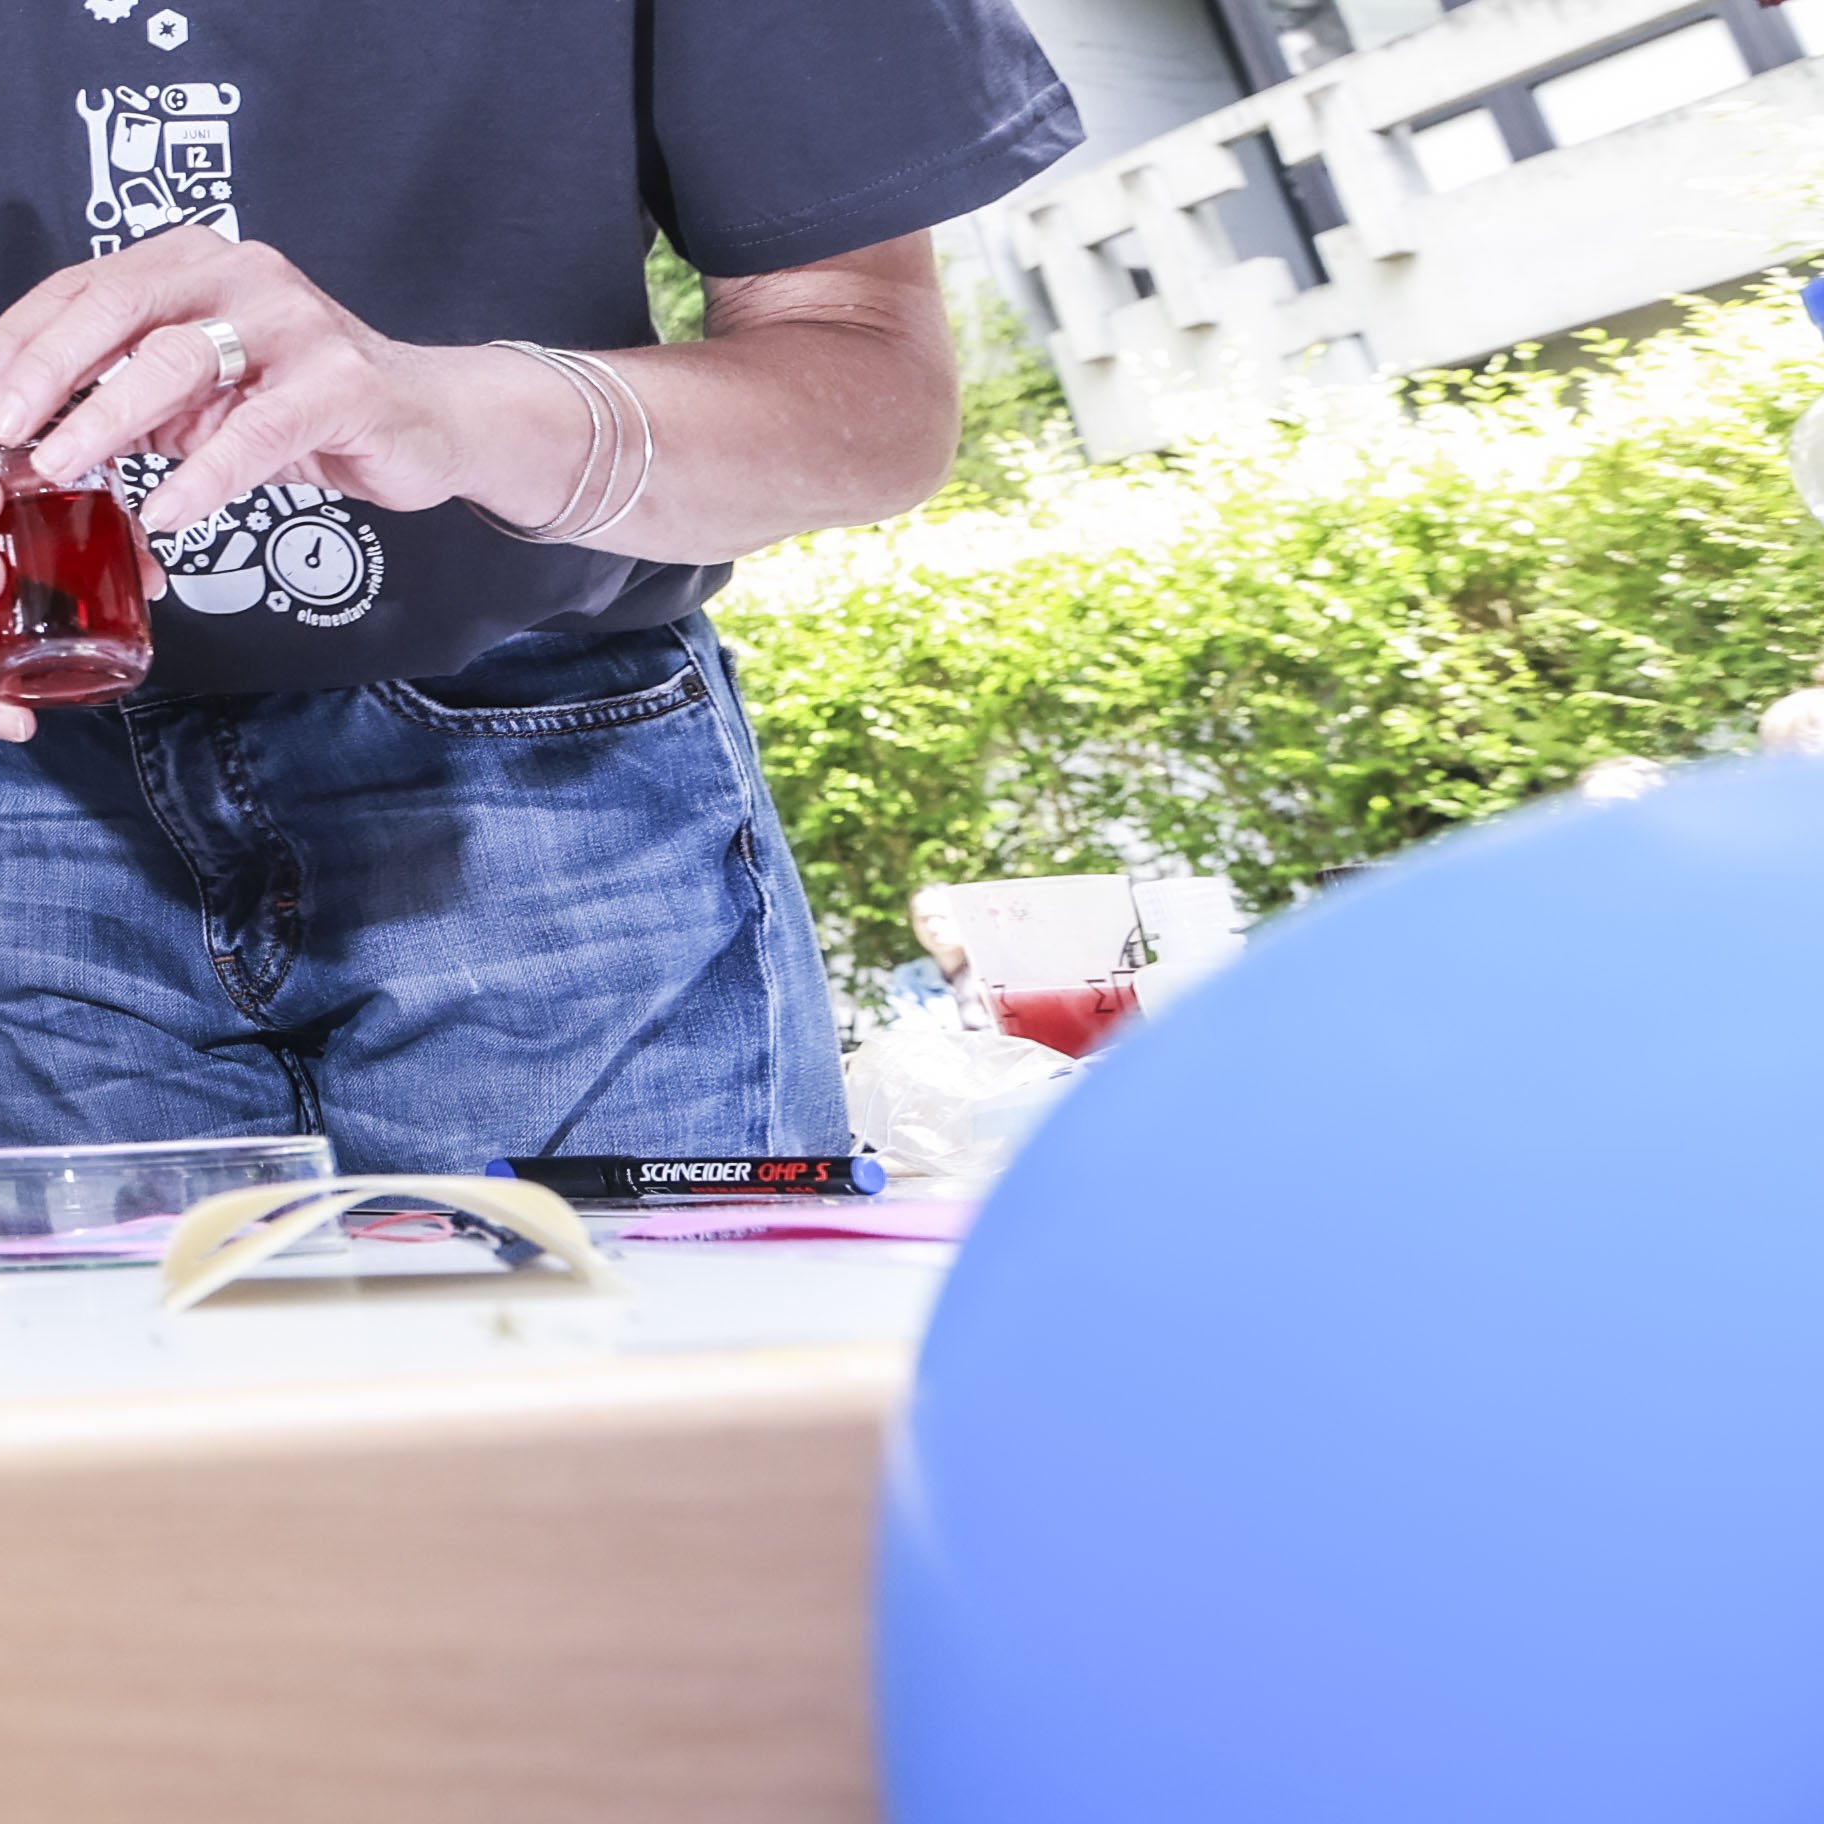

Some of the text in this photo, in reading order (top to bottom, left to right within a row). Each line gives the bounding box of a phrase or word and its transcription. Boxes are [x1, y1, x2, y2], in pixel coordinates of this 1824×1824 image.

[182, 128, 211, 140] JUNI
[186, 145, 212, 169] 12
[639, 1162, 833, 1183] SCHNEIDER OHP S
